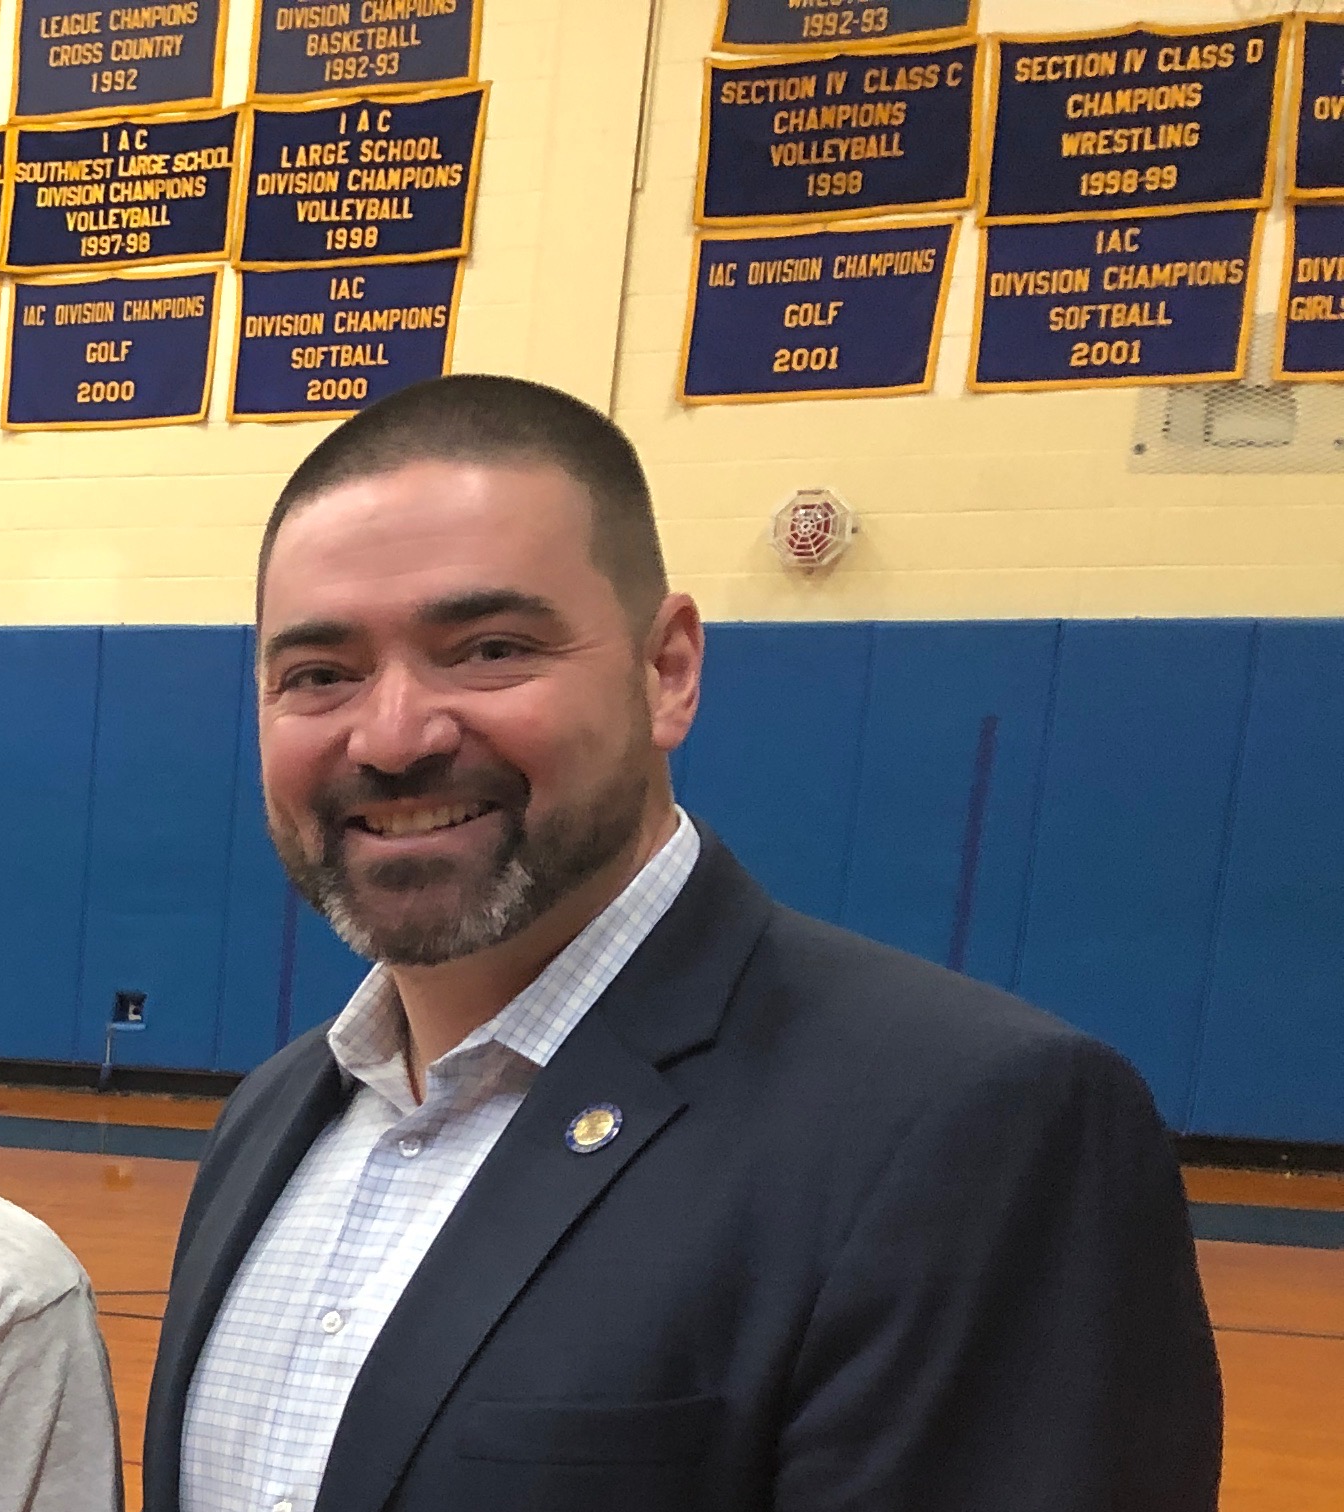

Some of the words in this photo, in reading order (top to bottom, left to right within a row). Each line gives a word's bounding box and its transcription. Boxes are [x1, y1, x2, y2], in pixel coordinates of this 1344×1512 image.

[40, 12, 102, 39] LEAGUE
[109, 2, 198, 32] CHAMPIONS
[276, 3, 350, 31] DIVISION
[361, 0, 457, 24] CHAMPIONS
[803, 7, 888, 37] 1992-93
[48, 44, 103, 68] CROSS
[111, 35, 184, 62] COUNTRY
[307, 24, 421, 56] BASKETBALL
[324, 56, 399, 81] 1992-93
[1015, 51, 1116, 83] SECTION
[1124, 48, 1147, 73] IV
[1158, 43, 1234, 73] CLASS
[1247, 39, 1263, 63] D
[92, 69, 137, 92] 1992
[721, 75, 816, 104] SECTION
[826, 71, 848, 95] IV
[864, 63, 940, 93] CLASS
[946, 62, 963, 87] C
[1067, 82, 1203, 119] CHAMPIONS
[774, 101, 907, 134] CHAMPIONS
[280, 141, 350, 168] LARGE
[359, 137, 442, 162] SCHOOL
[771, 132, 904, 167] VOLLEYBALL
[1062, 122, 1200, 157] WRESTLING
[15, 159, 114, 182] SOUTHWEST
[118, 154, 169, 177] LARGE
[173, 147, 233, 170] SCHOOL
[36, 184, 104, 208] DIVISION
[109, 177, 206, 203] CHAMPIONS
[256, 170, 338, 195] DIVISION
[346, 165, 462, 192] CHAMPIONS
[806, 171, 863, 197] 1998
[1080, 165, 1177, 196] 1998-99
[65, 206, 171, 233] VOLLEYBALL
[296, 197, 413, 223] VOLLEYBALL
[80, 234, 150, 256] 1997-98
[325, 227, 378, 250] 1998
[1096, 228, 1139, 254] IAC
[709, 262, 735, 287] IAC
[748, 258, 822, 286] DIVISION
[833, 248, 936, 281] CHAMPIONS
[990, 269, 1090, 297] DIVISION
[1103, 259, 1244, 290] CHAMPIONS
[330, 278, 364, 300] IAC
[23, 304, 46, 326] IAC
[55, 301, 114, 326] DIVISION
[122, 296, 204, 322] CHAMPIONS
[245, 313, 323, 338] DIVISION
[333, 306, 446, 334] CHAMPIONS
[785, 302, 843, 327] GOLF
[1049, 302, 1172, 331] SOFTBALL
[85, 341, 132, 363] GOLF
[291, 344, 388, 369] SOFTBALL
[773, 347, 838, 372] 2001
[1070, 340, 1141, 366] 2001
[77, 381, 135, 403] 2000
[307, 378, 367, 401] 2000
